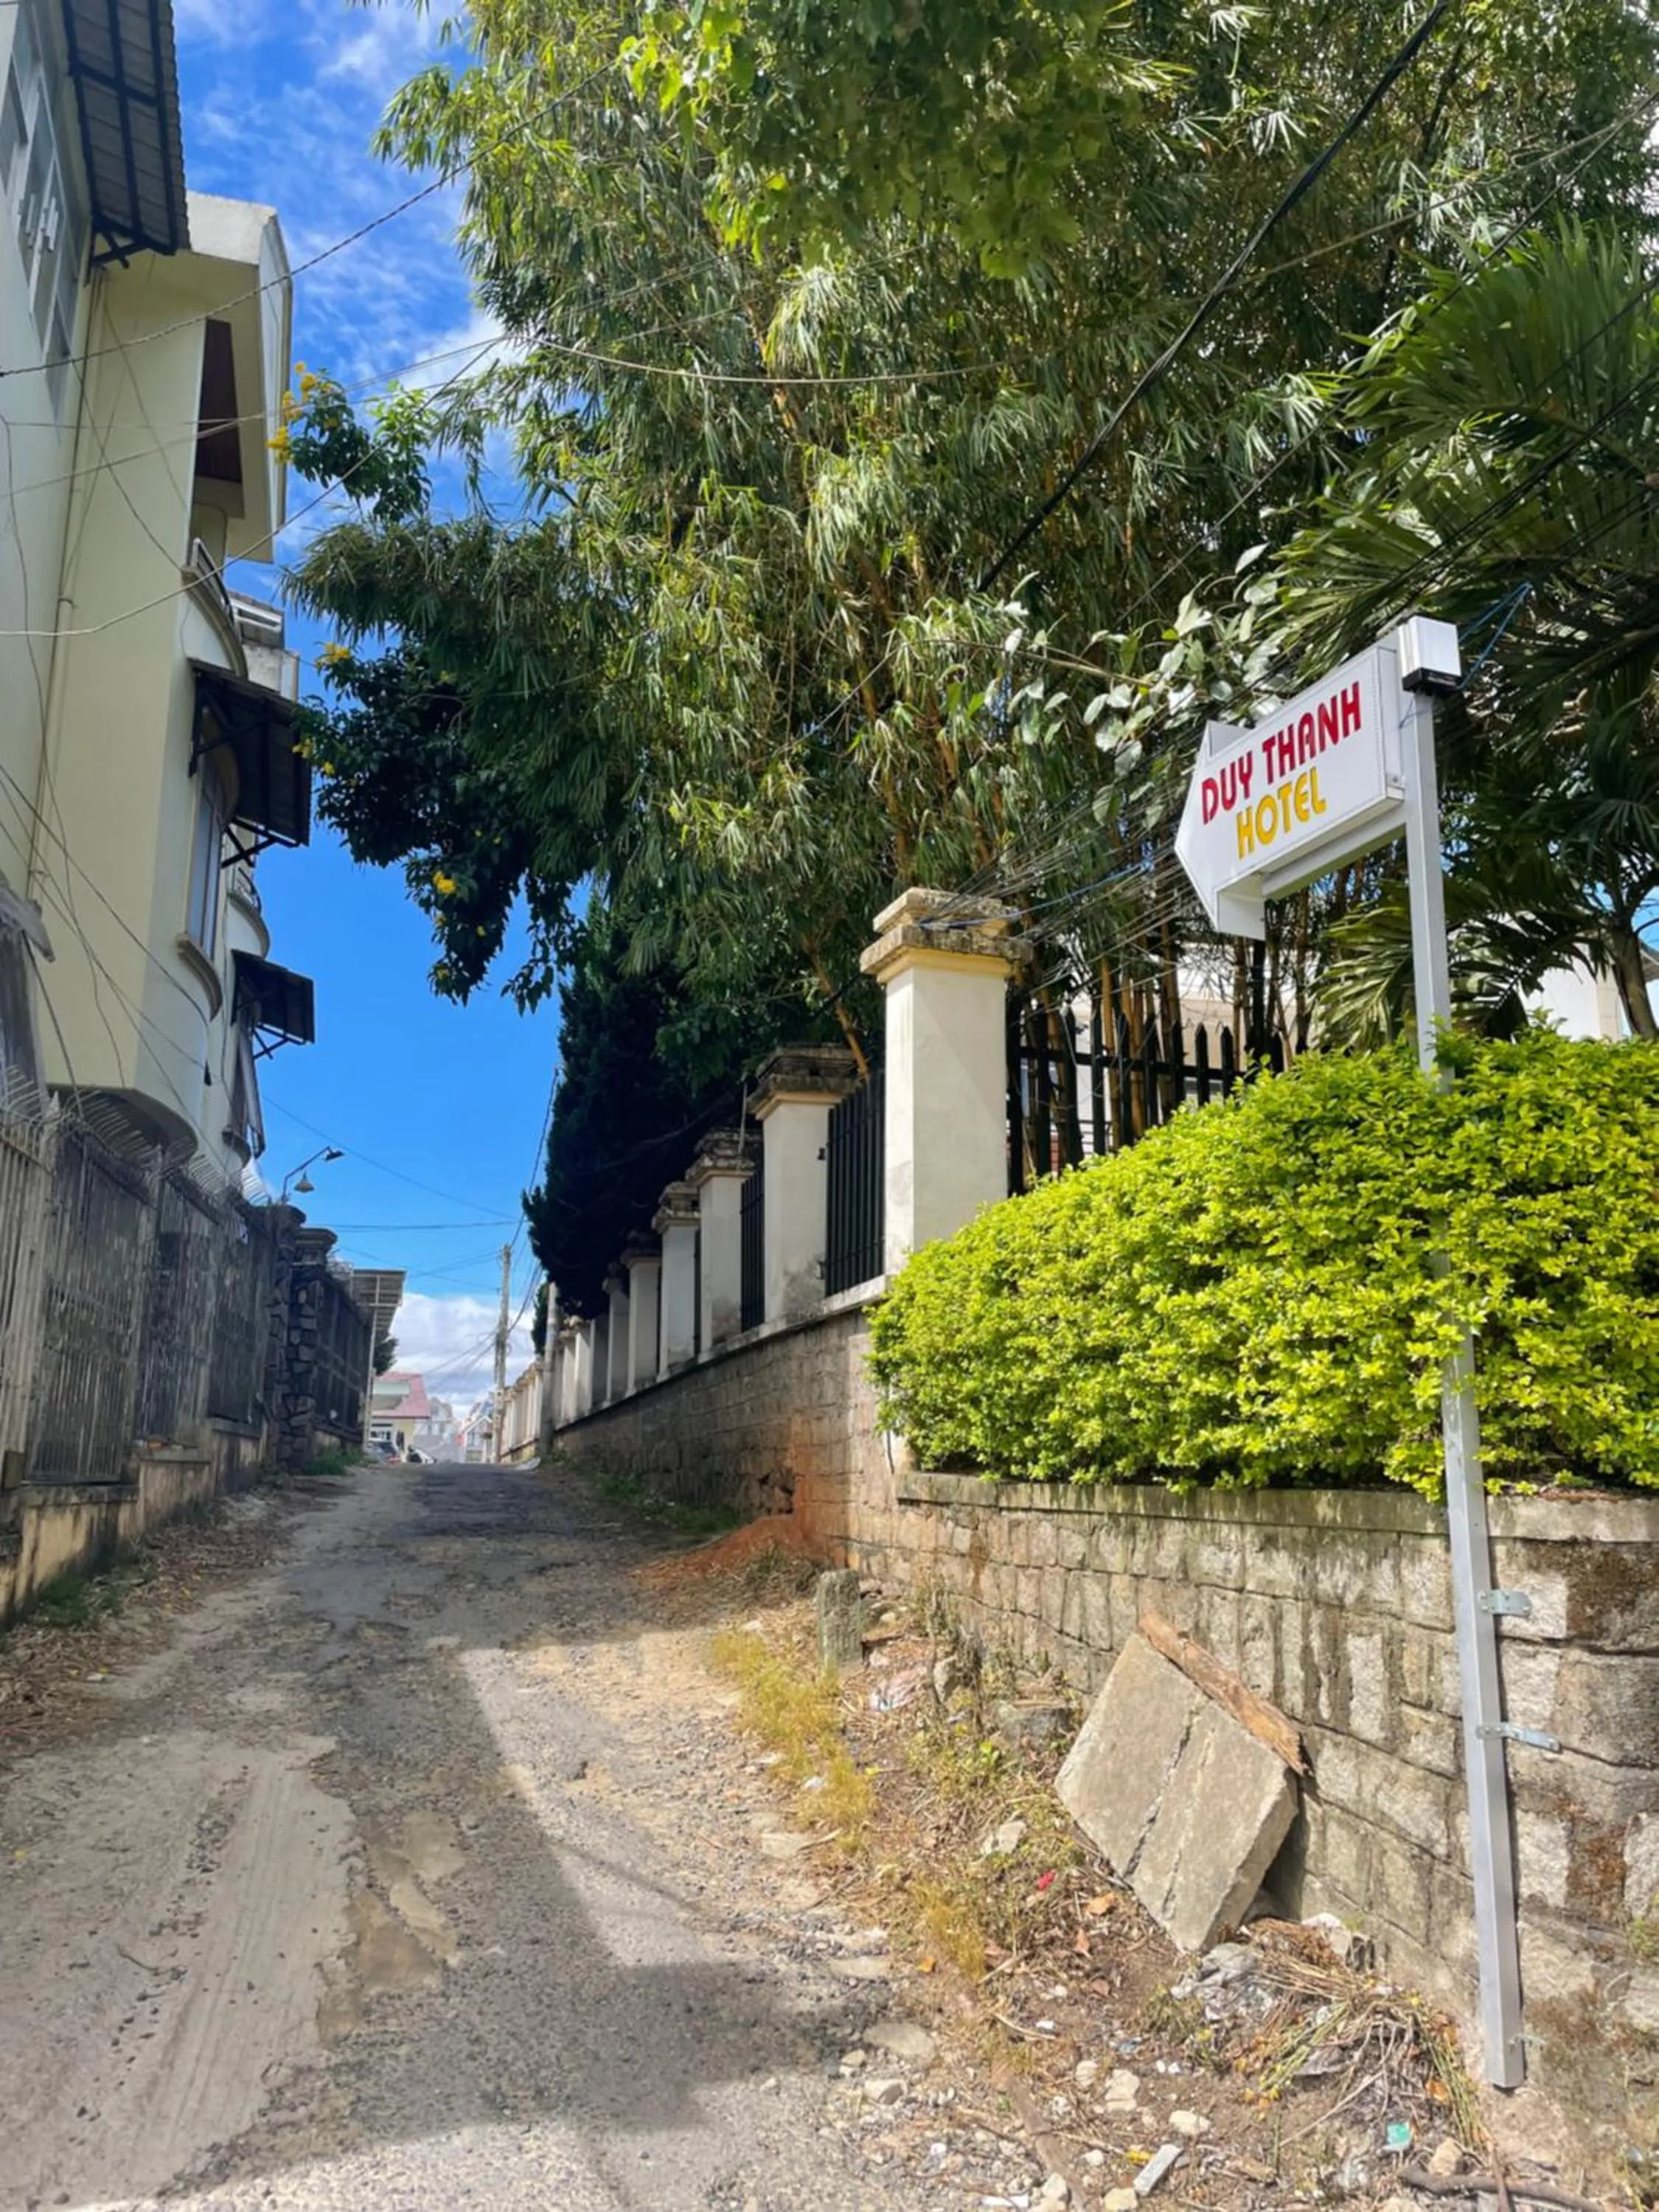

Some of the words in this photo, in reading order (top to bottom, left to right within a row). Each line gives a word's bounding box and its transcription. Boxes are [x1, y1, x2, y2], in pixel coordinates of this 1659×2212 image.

[1202, 751, 1253, 824] DUY
[1262, 682, 1361, 784] THANH
[1237, 767, 1326, 858] HOTEL
